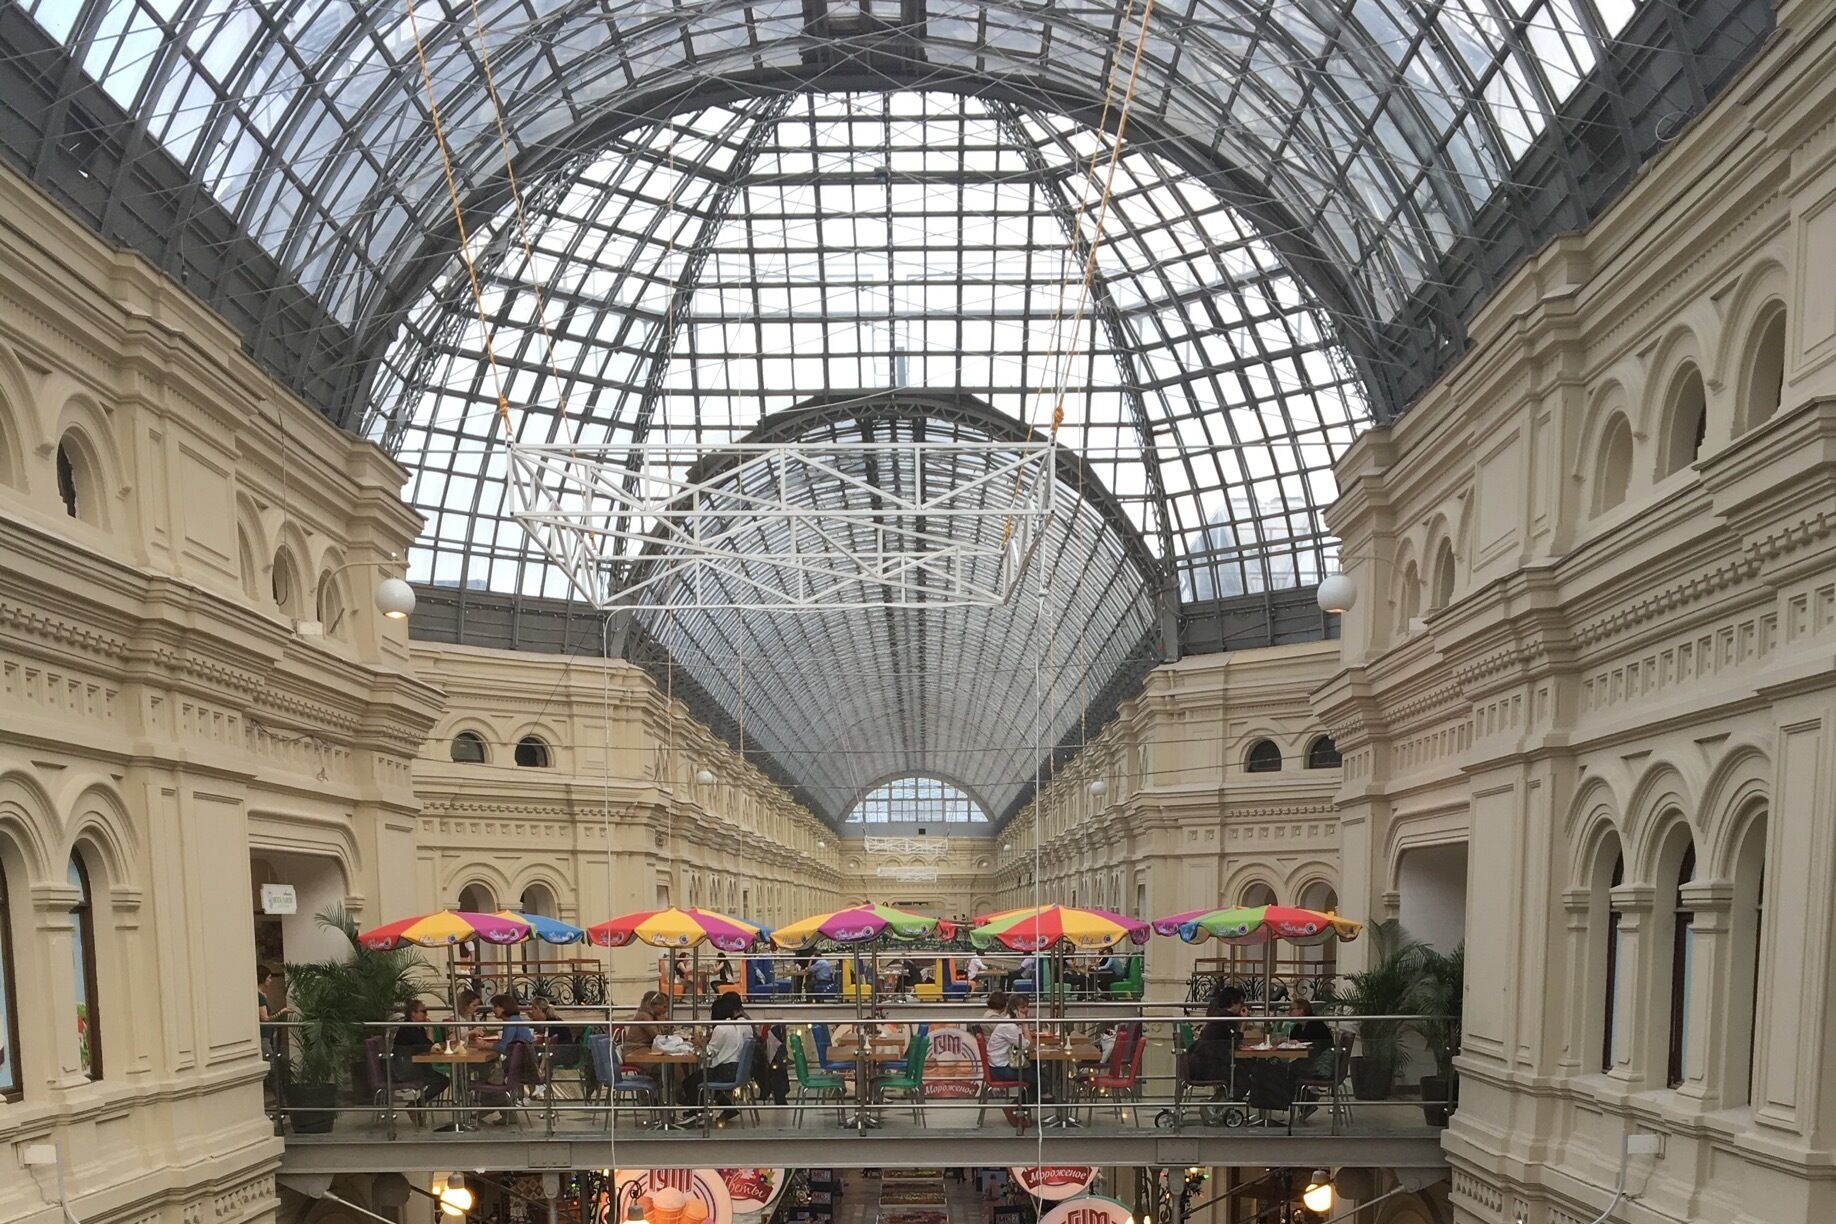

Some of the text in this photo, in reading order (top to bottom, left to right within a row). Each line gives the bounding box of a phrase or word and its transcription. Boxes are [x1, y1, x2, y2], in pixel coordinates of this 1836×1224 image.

[933, 1034, 961, 1055] ГУМ
[924, 1084, 975, 1096] Мороженое
[1029, 1169, 1087, 1184] Мороженое
